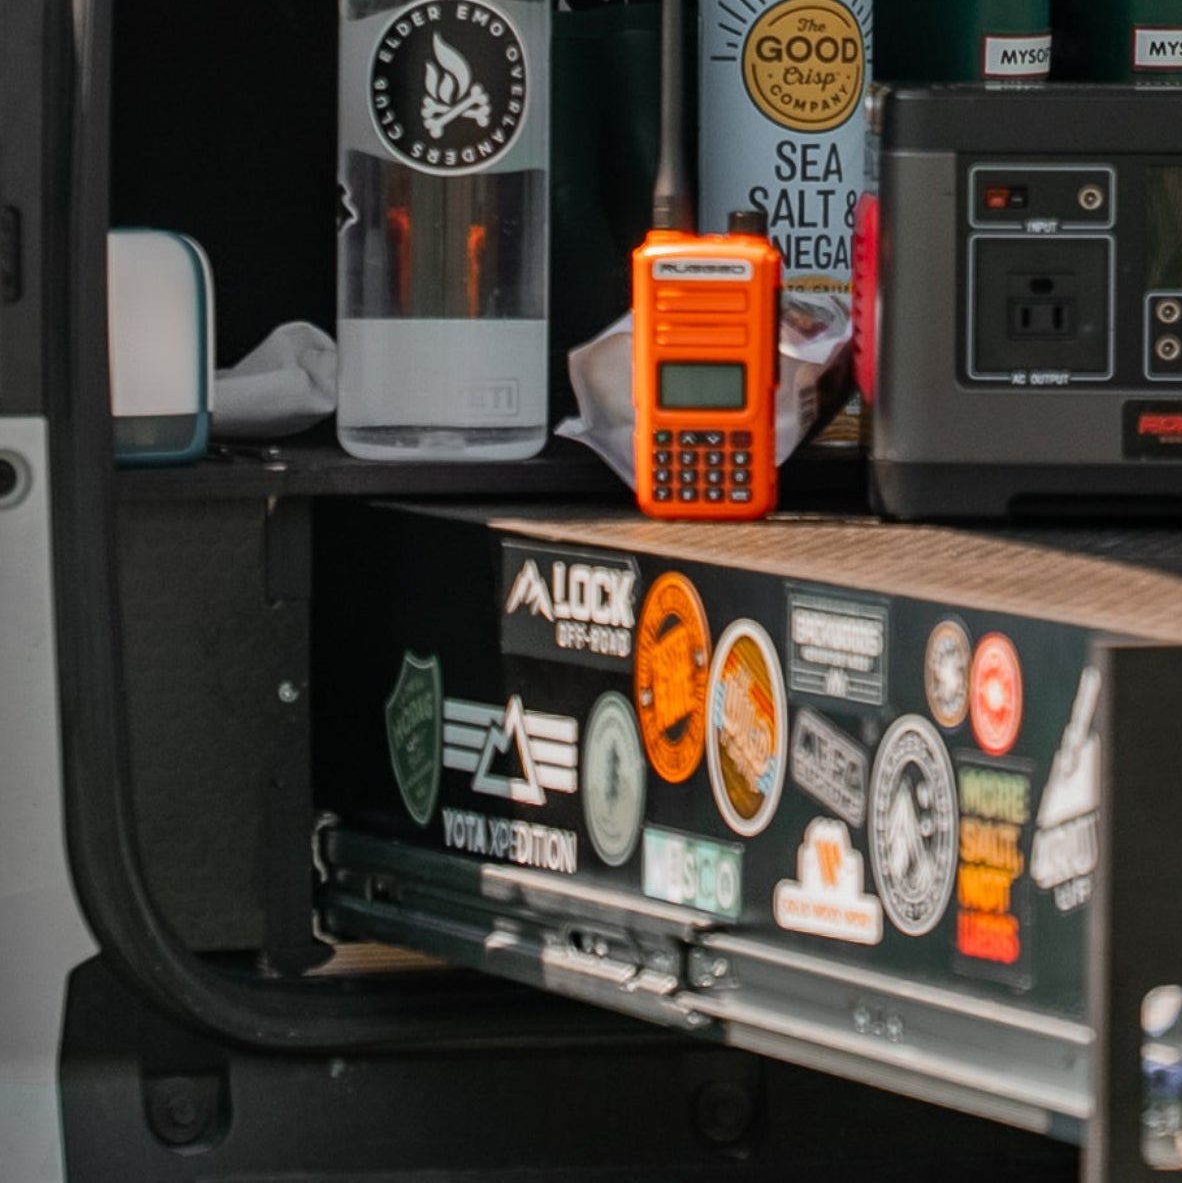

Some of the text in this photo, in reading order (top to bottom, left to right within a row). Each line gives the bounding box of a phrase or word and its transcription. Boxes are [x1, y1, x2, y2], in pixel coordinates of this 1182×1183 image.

[379, 4, 441, 64] ELDER
[456, 4, 504, 37] EMO
[797, 18, 826, 33] The
[755, 35, 859, 64] GOOD
[783, 66, 835, 93] Crisp
[373, 76, 403, 140] CLUB
[410, 46, 524, 166] OVERLANDERS
[769, 84, 848, 112] COMPANY
[774, 140, 843, 183] SEA
[748, 186, 836, 228] SALT
[772, 234, 852, 270] NEGA
[1011, 374, 1069, 386] AC OUTPUT
